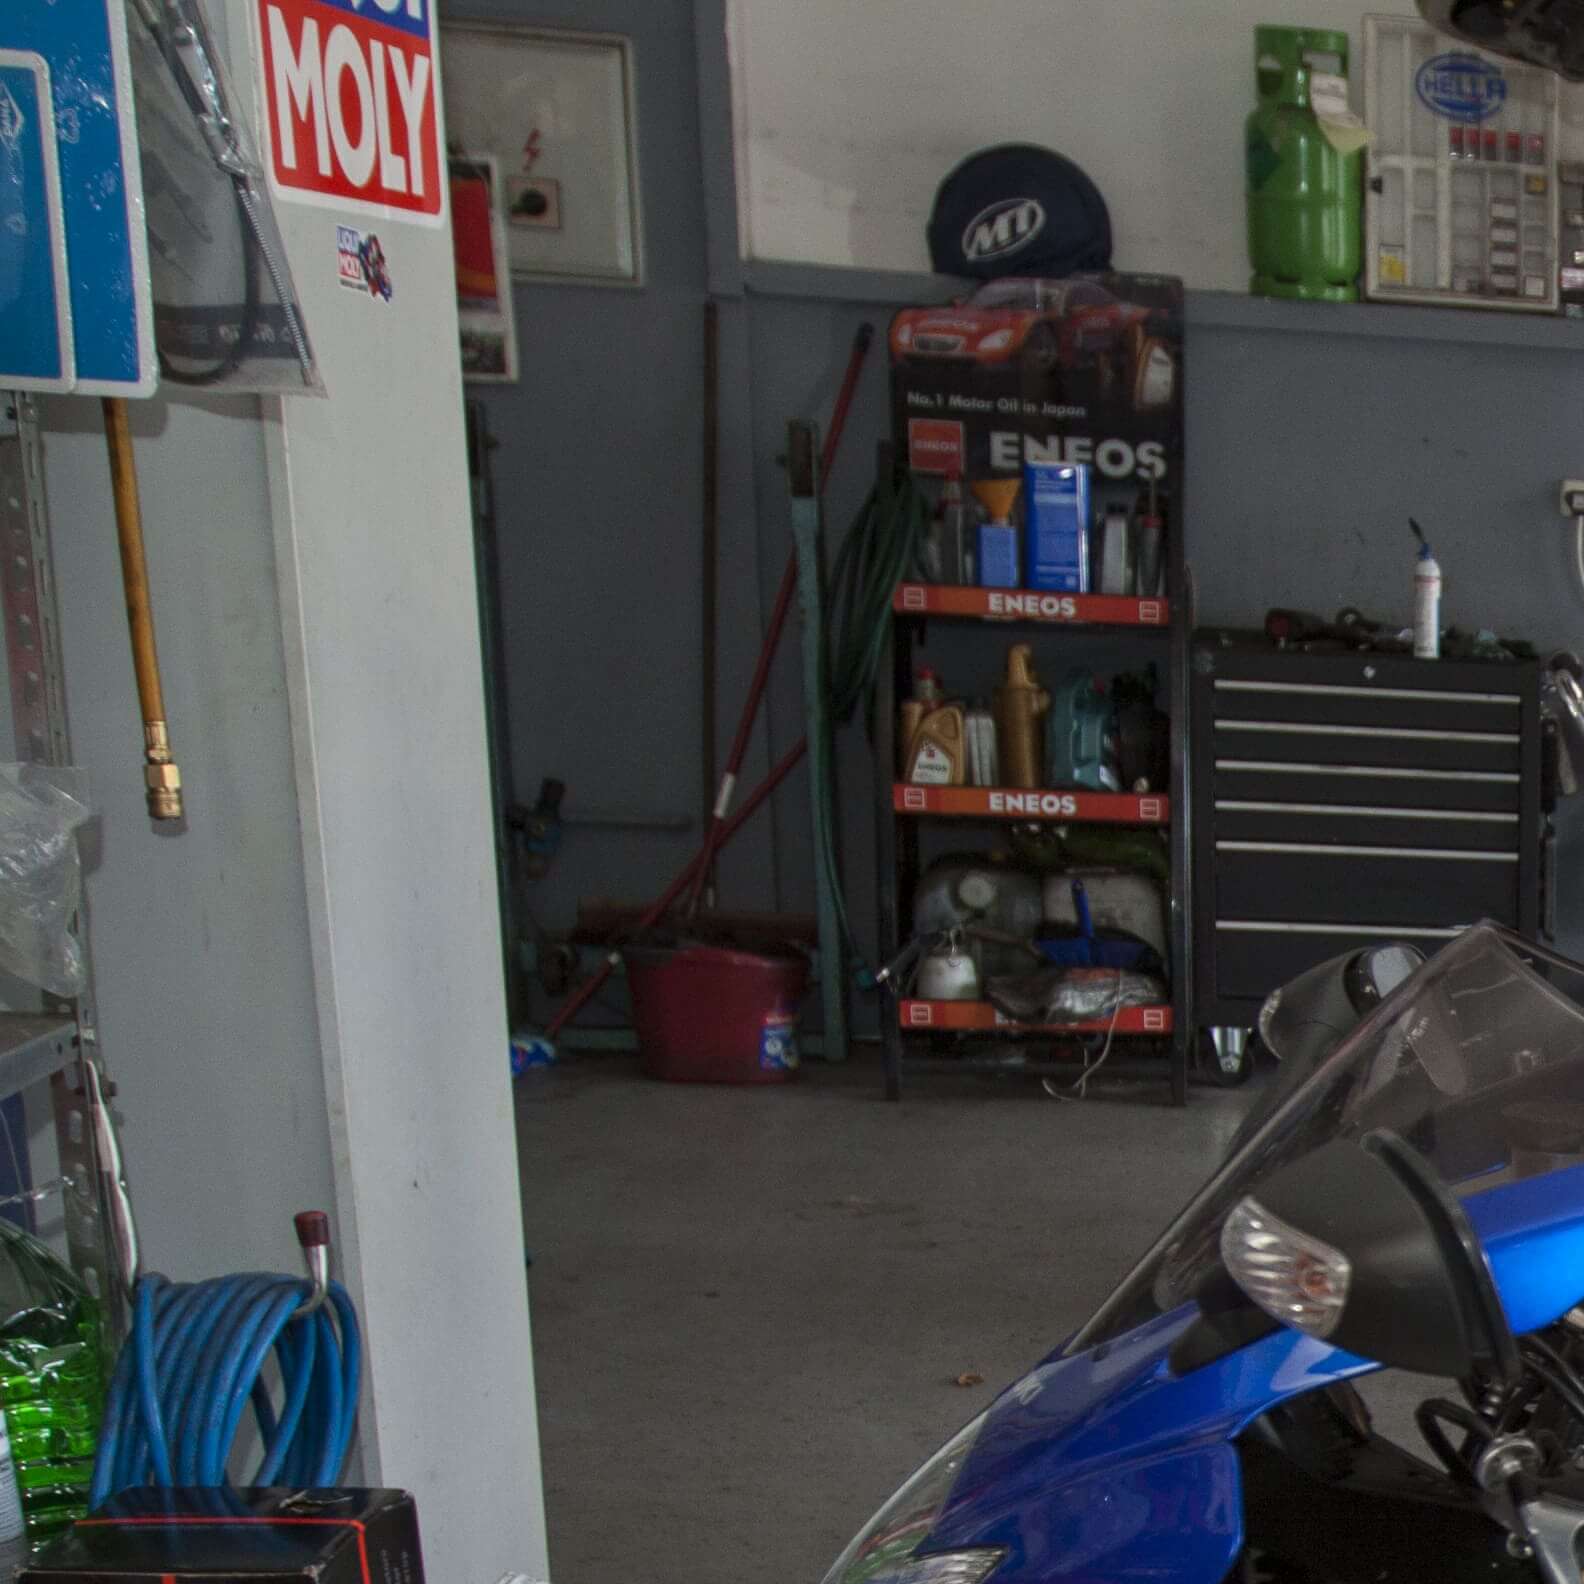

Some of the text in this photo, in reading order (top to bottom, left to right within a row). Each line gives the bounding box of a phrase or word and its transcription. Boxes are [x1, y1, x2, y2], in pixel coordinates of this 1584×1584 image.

[267, 4, 430, 198] MOLY
[950, 394, 992, 410] Motor
[997, 397, 1018, 412] Oil
[1041, 402, 1086, 418] Japan
[989, 431, 1167, 480] ENEOS
[988, 592, 1076, 617] ENEOS
[989, 791, 1077, 815] ENEOS
